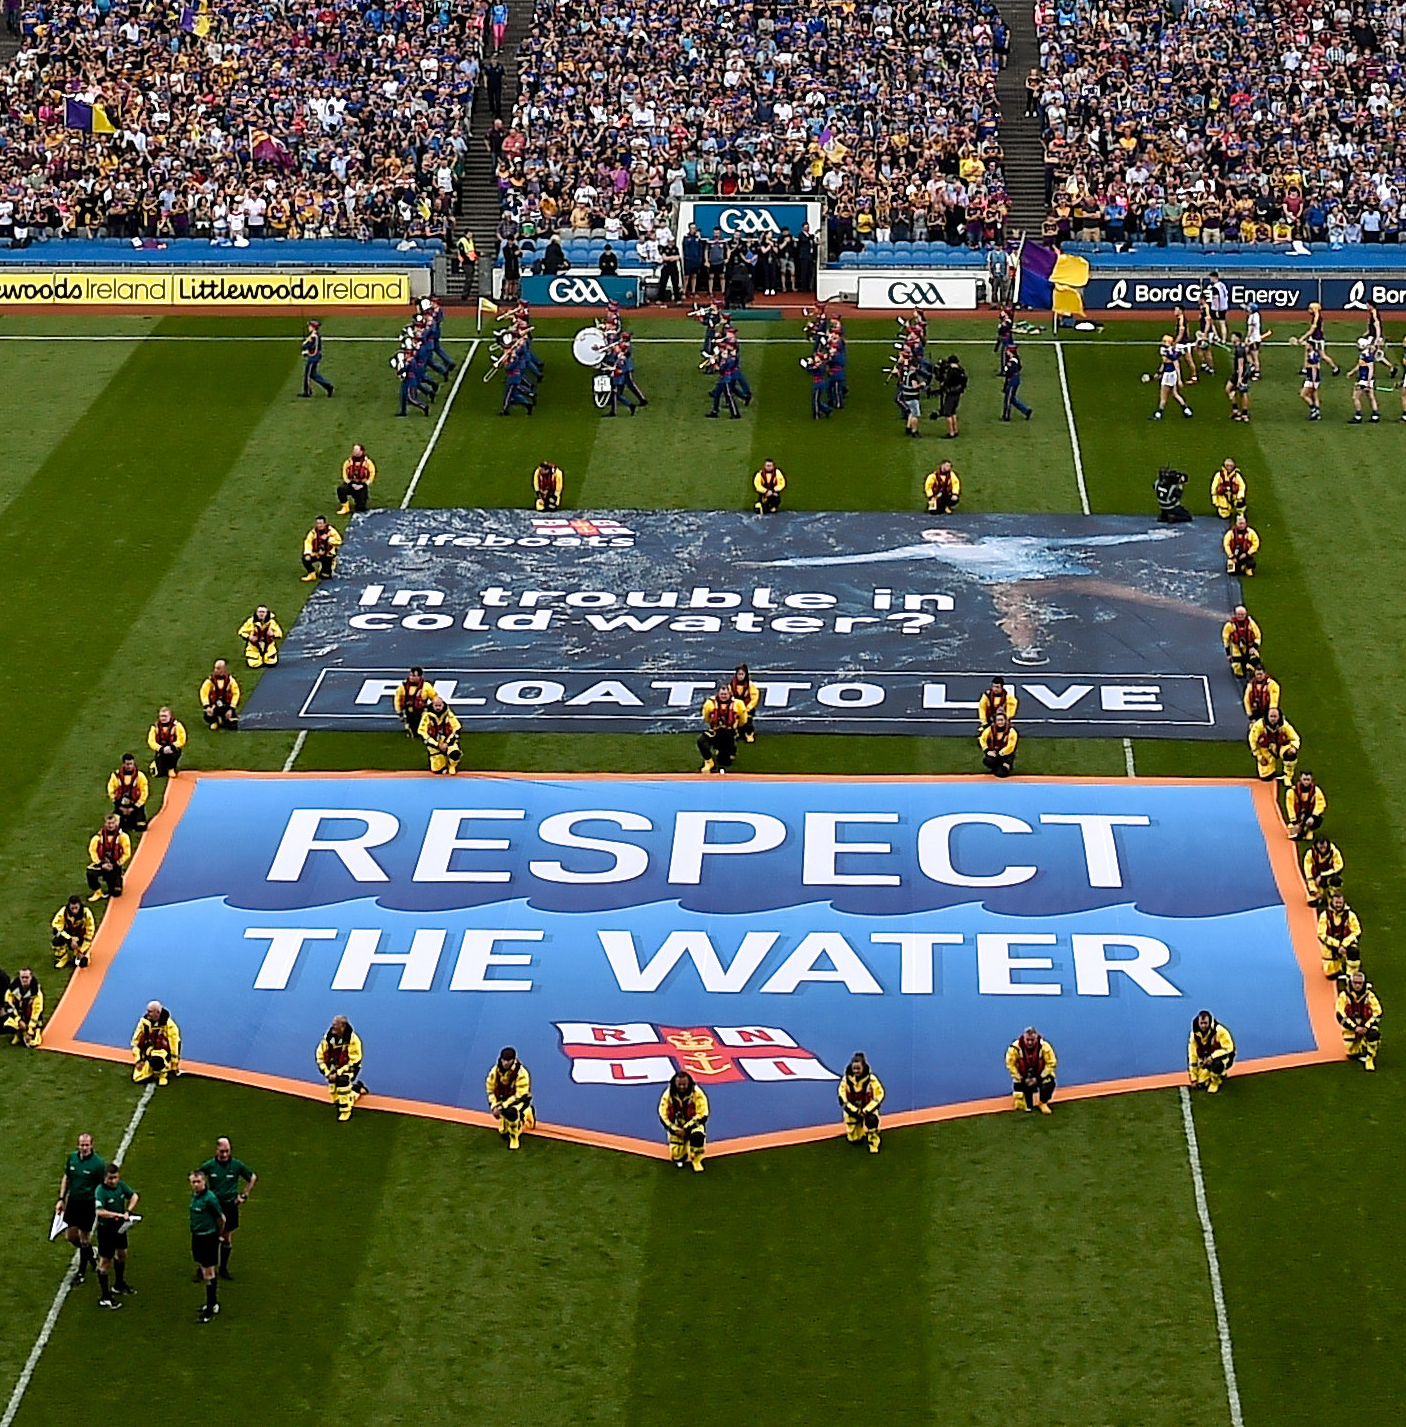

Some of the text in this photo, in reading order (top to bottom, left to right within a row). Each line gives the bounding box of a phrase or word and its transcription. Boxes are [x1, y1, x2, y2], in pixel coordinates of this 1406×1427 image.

[720, 210, 780, 235] GAA
[549, 279, 608, 302] GAA
[888, 282, 945, 304] GAA
[1136, 284, 1182, 301] Bord
[1232, 286, 1300, 306] Energy
[389, 532, 634, 551] Lifeboats
[359, 585, 954, 610] In trouble in
[348, 609, 936, 634] cold water?
[759, 682, 884, 709] TO
[267, 809, 1149, 887] RESPECT
[244, 928, 1181, 995] THE WATER
